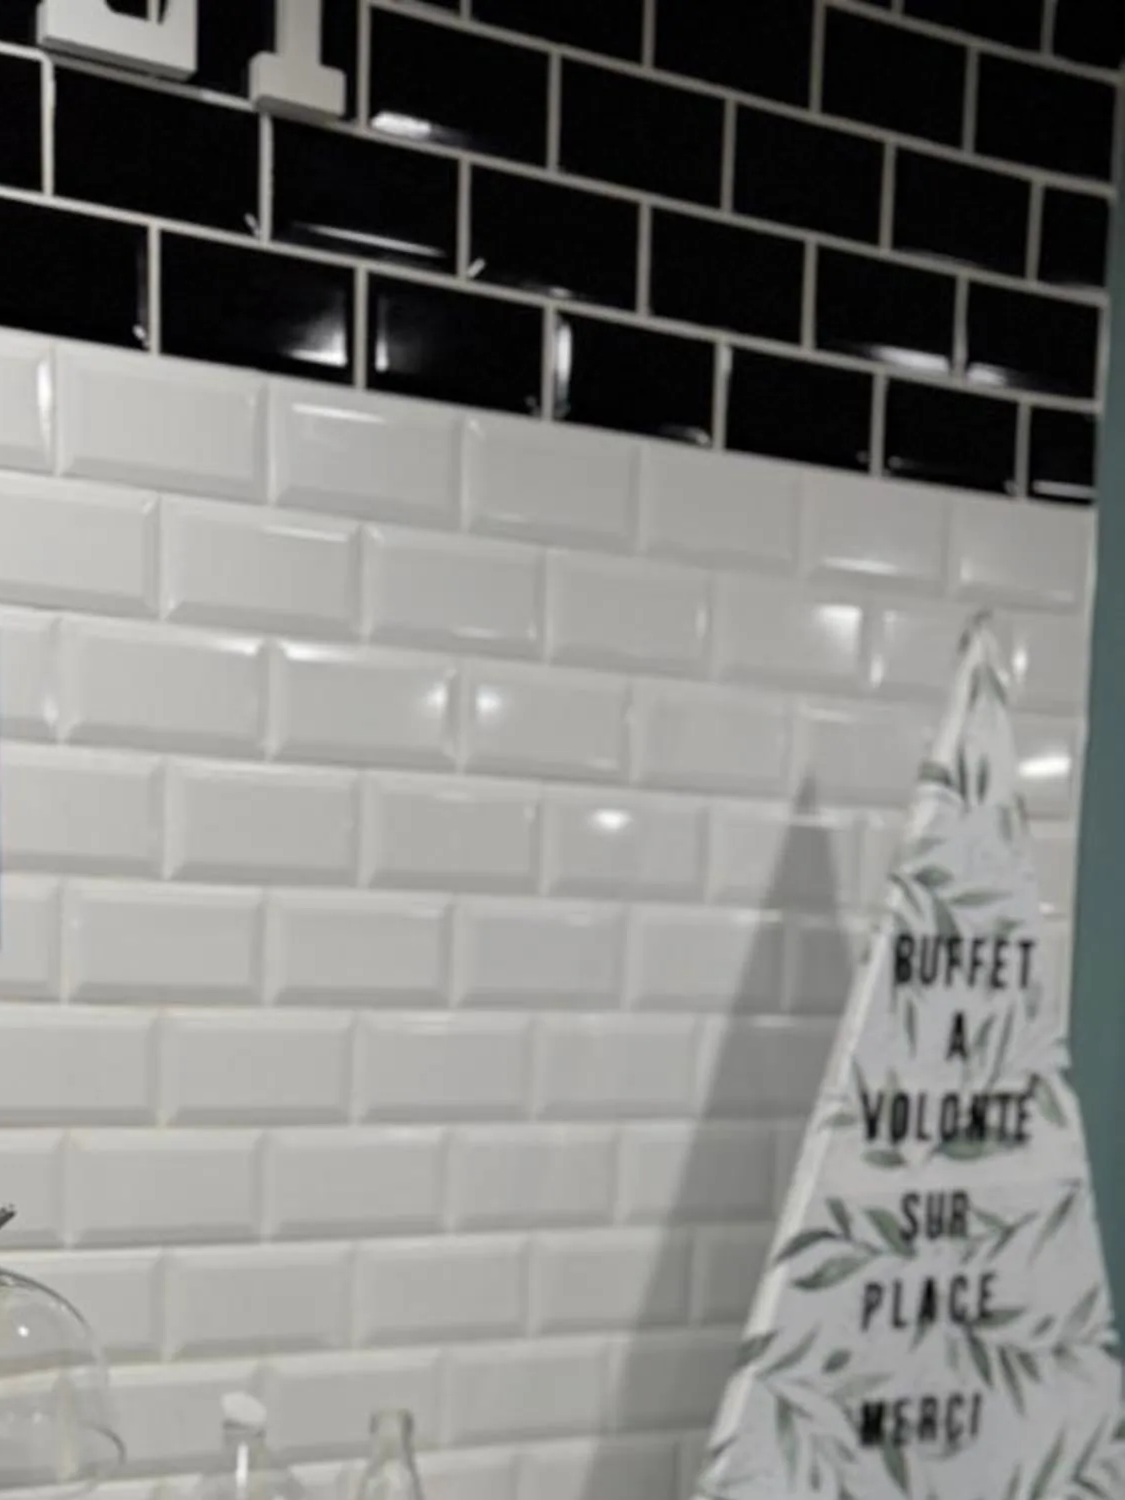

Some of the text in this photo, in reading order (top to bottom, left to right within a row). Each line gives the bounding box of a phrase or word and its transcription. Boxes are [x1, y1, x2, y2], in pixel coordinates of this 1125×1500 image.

[894, 933, 1036, 989] BUFFET
[945, 1010, 969, 1062] A
[860, 1091, 1031, 1143] VOLONTE
[900, 1189, 968, 1240] SUR
[860, 1270, 995, 1332] PLACE
[859, 1392, 982, 1448] MERCI
